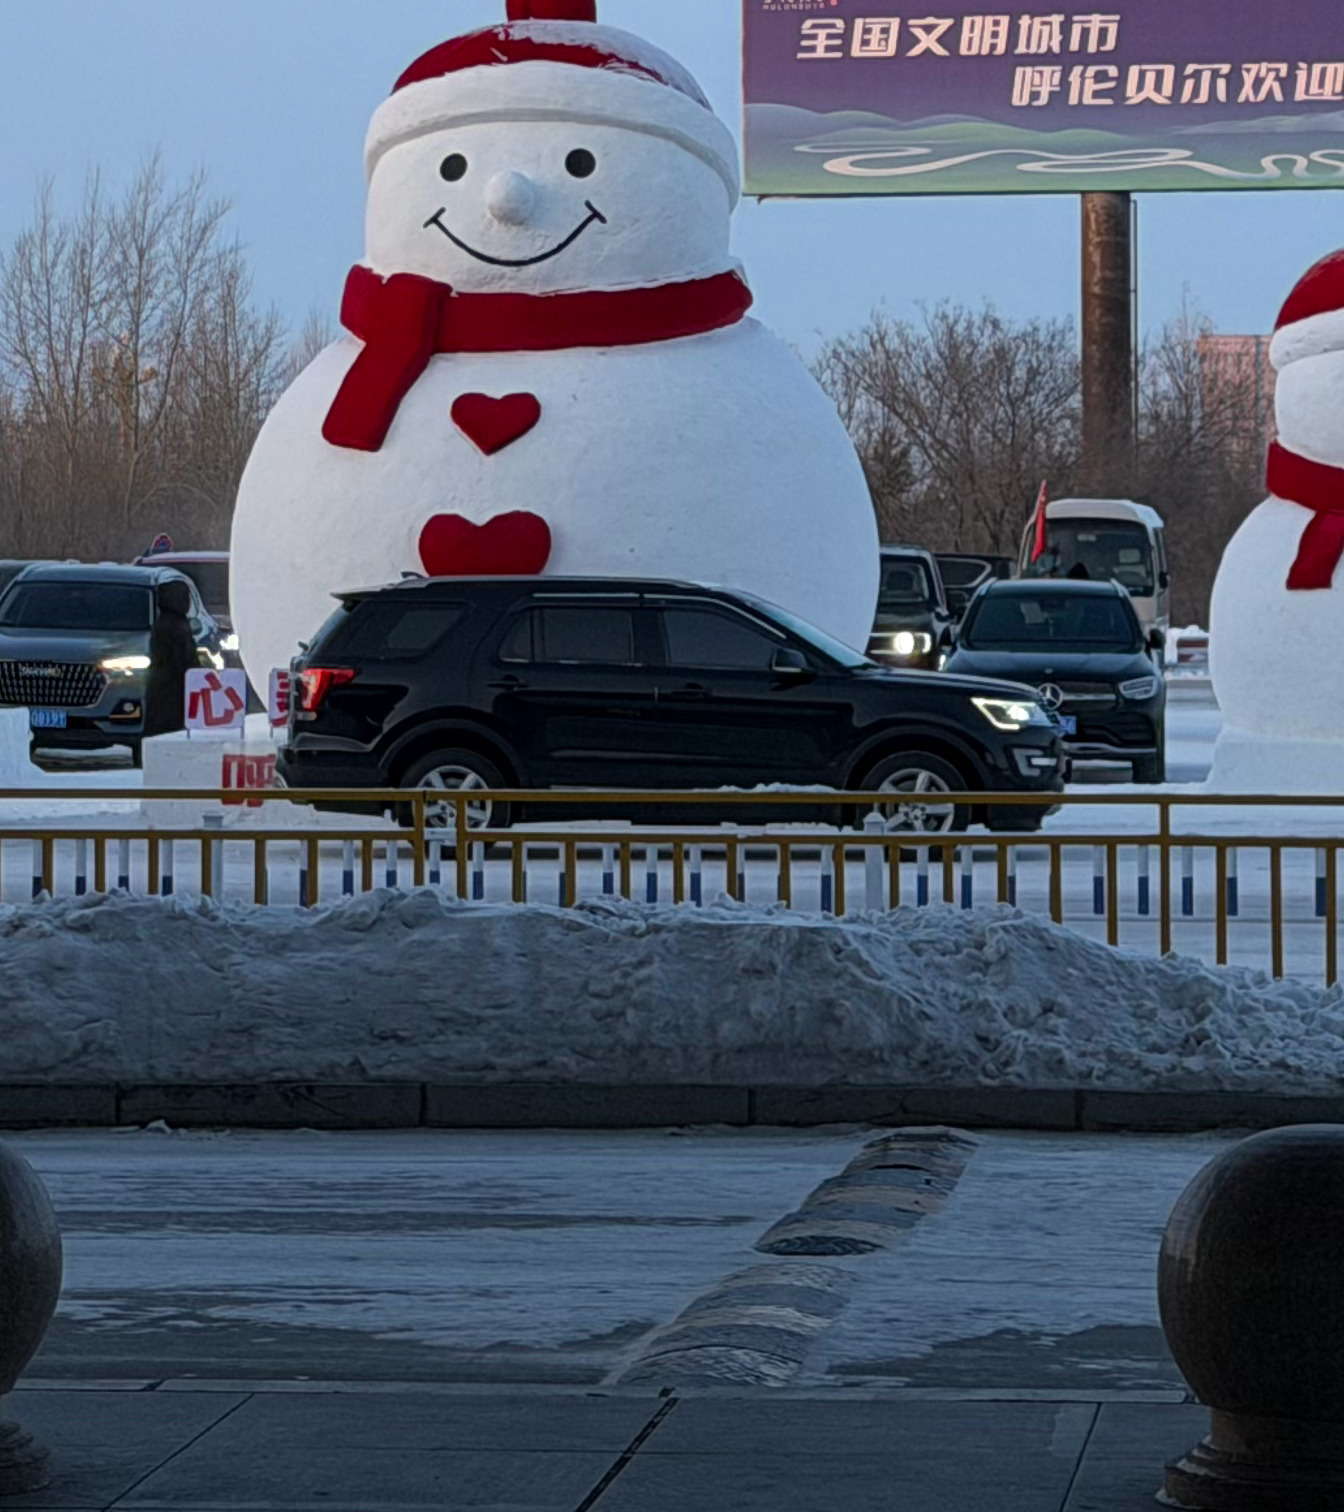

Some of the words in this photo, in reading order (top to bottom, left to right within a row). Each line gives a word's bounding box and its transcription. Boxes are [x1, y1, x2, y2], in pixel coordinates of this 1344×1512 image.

[795, 13, 1121, 59] 全国文明城市
